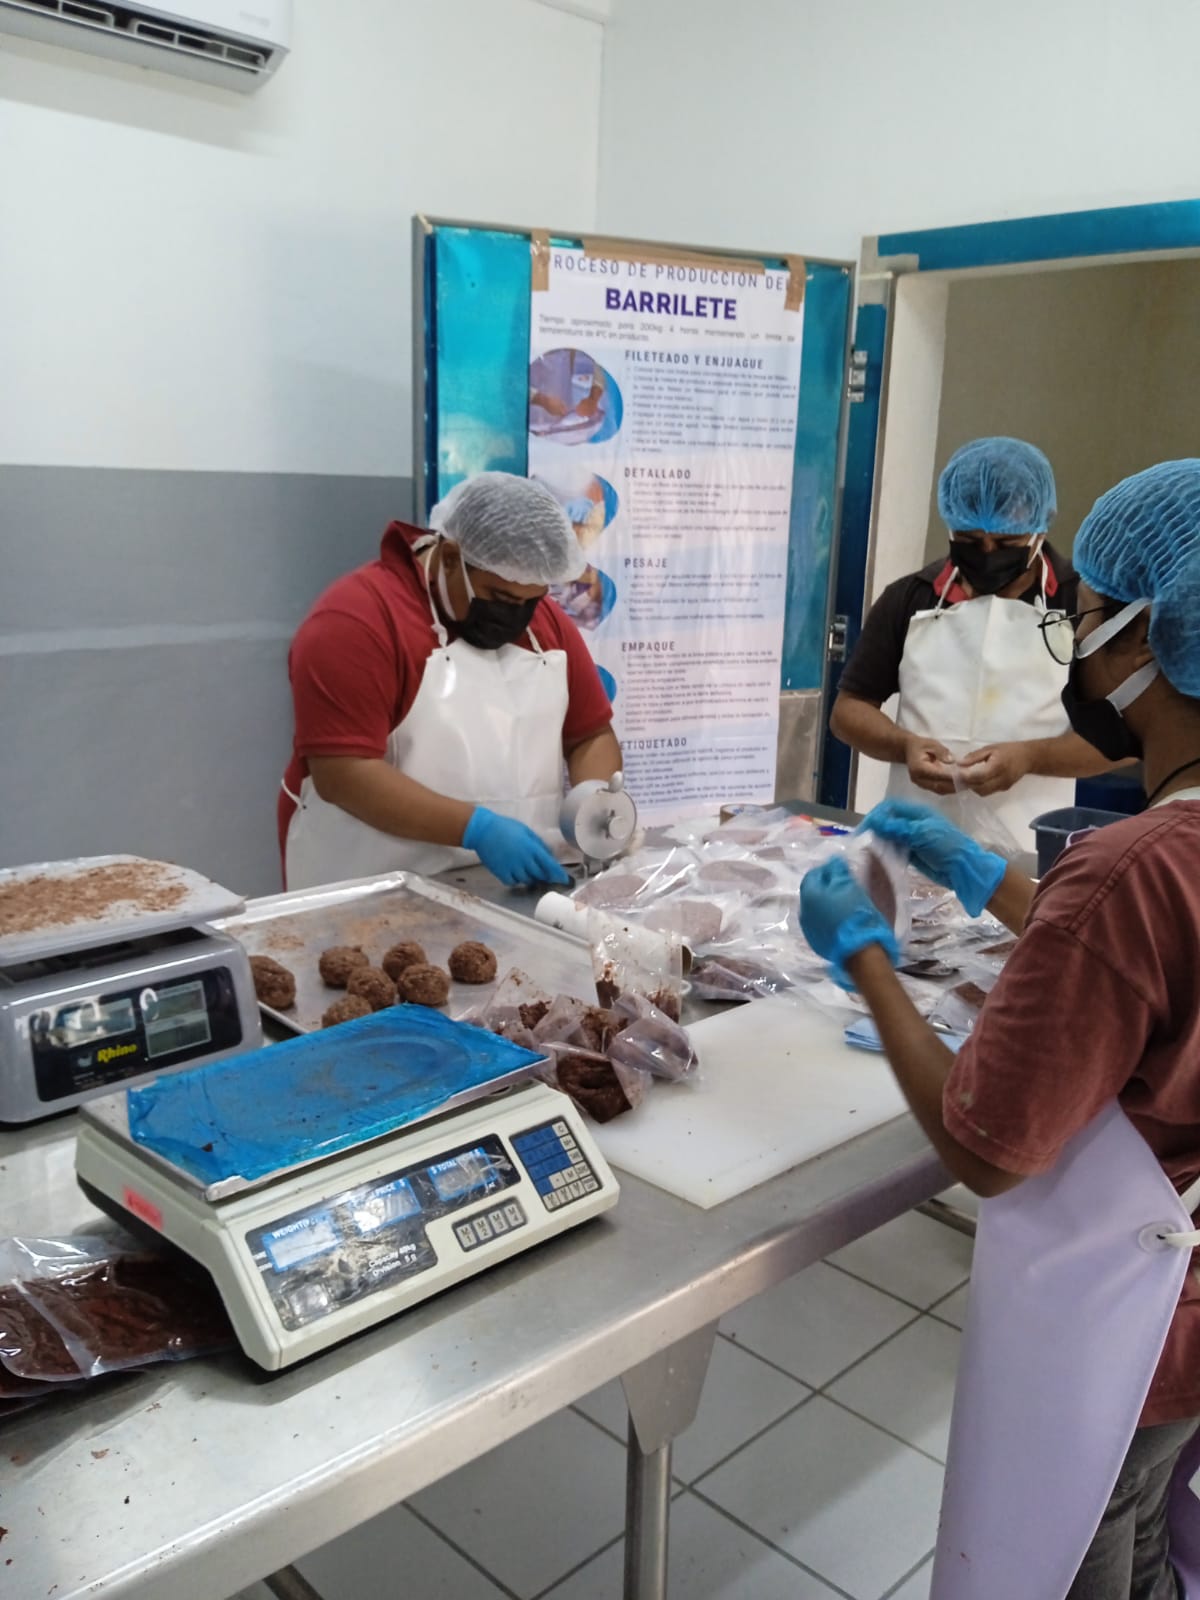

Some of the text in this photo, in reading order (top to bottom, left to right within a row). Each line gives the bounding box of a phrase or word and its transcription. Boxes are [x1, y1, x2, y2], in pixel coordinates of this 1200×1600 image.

[553, 254, 620, 275] ROCESO
[628, 260, 647, 278] DE
[605, 287, 738, 320] BARRILETE
[625, 349, 764, 370] FILETEADO Y ENJUAGUE
[624, 466, 691, 480] DETALLADO
[624, 557, 668, 569] PESAJE
[621, 640, 675, 652] EMPAQUE
[620, 737, 687, 751] ETIQUETADO
[97, 1043, 138, 1063] Rhino
